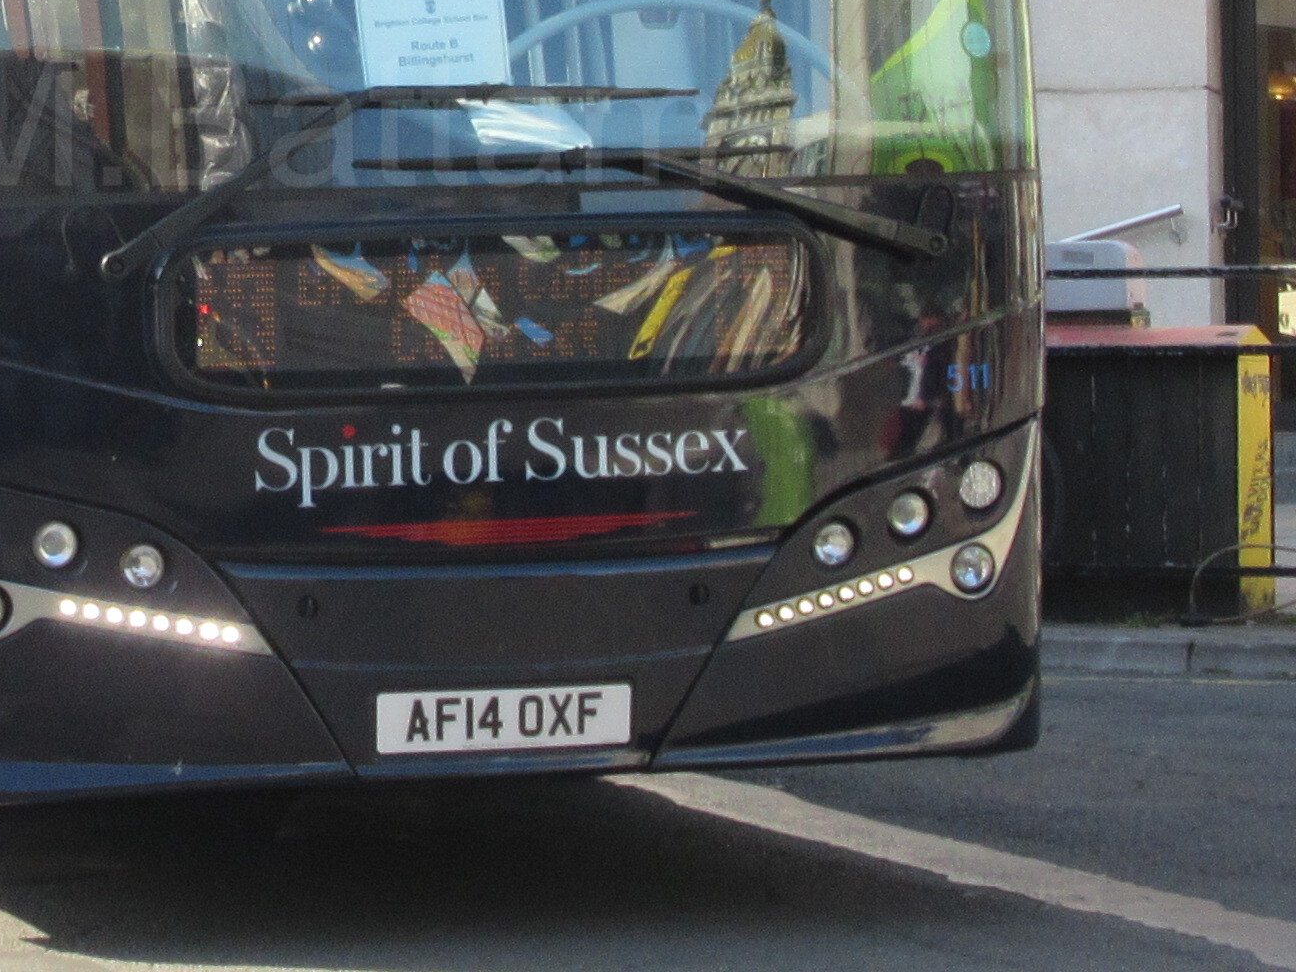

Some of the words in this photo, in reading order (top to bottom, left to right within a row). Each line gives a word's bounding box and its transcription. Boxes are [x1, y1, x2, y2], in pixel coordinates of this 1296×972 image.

[398, 53, 474, 68] Billingshurst
[410, 39, 446, 51] Route
[254, 424, 431, 508] Spirit
[443, 418, 512, 485] of
[525, 417, 749, 482] Sussex
[406, 695, 504, 742] AF14
[518, 691, 603, 737] OXF
